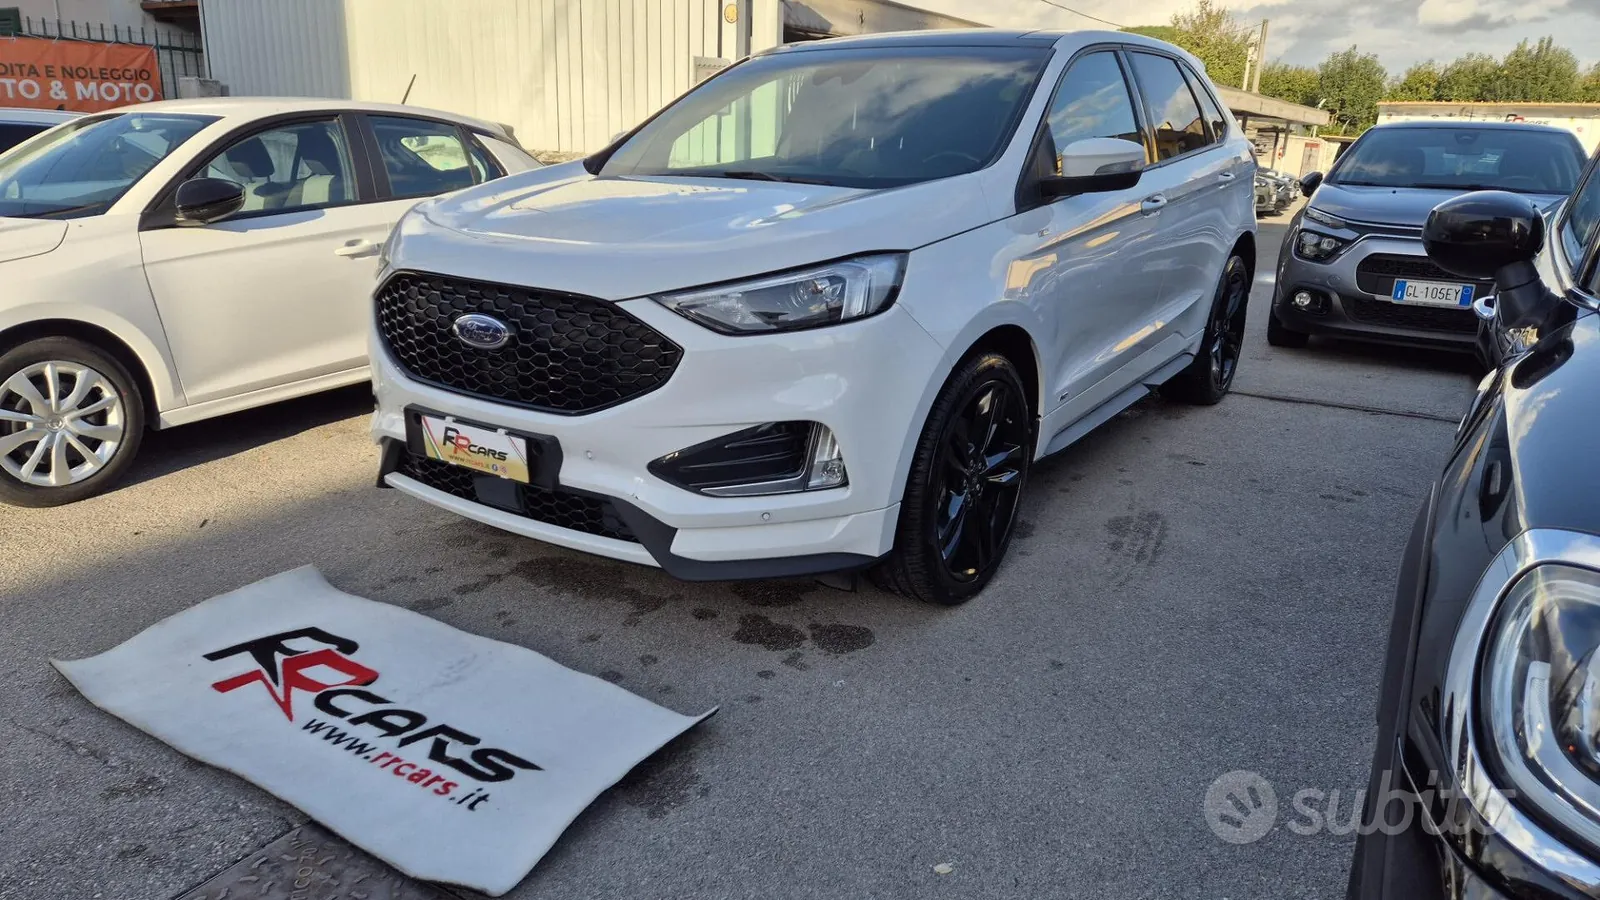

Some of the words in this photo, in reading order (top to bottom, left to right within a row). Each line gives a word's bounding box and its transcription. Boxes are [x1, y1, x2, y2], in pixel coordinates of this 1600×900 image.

[45, 65, 56, 78] E
[61, 66, 151, 80] NOLEGGIO
[50, 81, 68, 100] &
[75, 82, 154, 102] MOTO
[302, 718, 490, 811] www.rrcars.it
